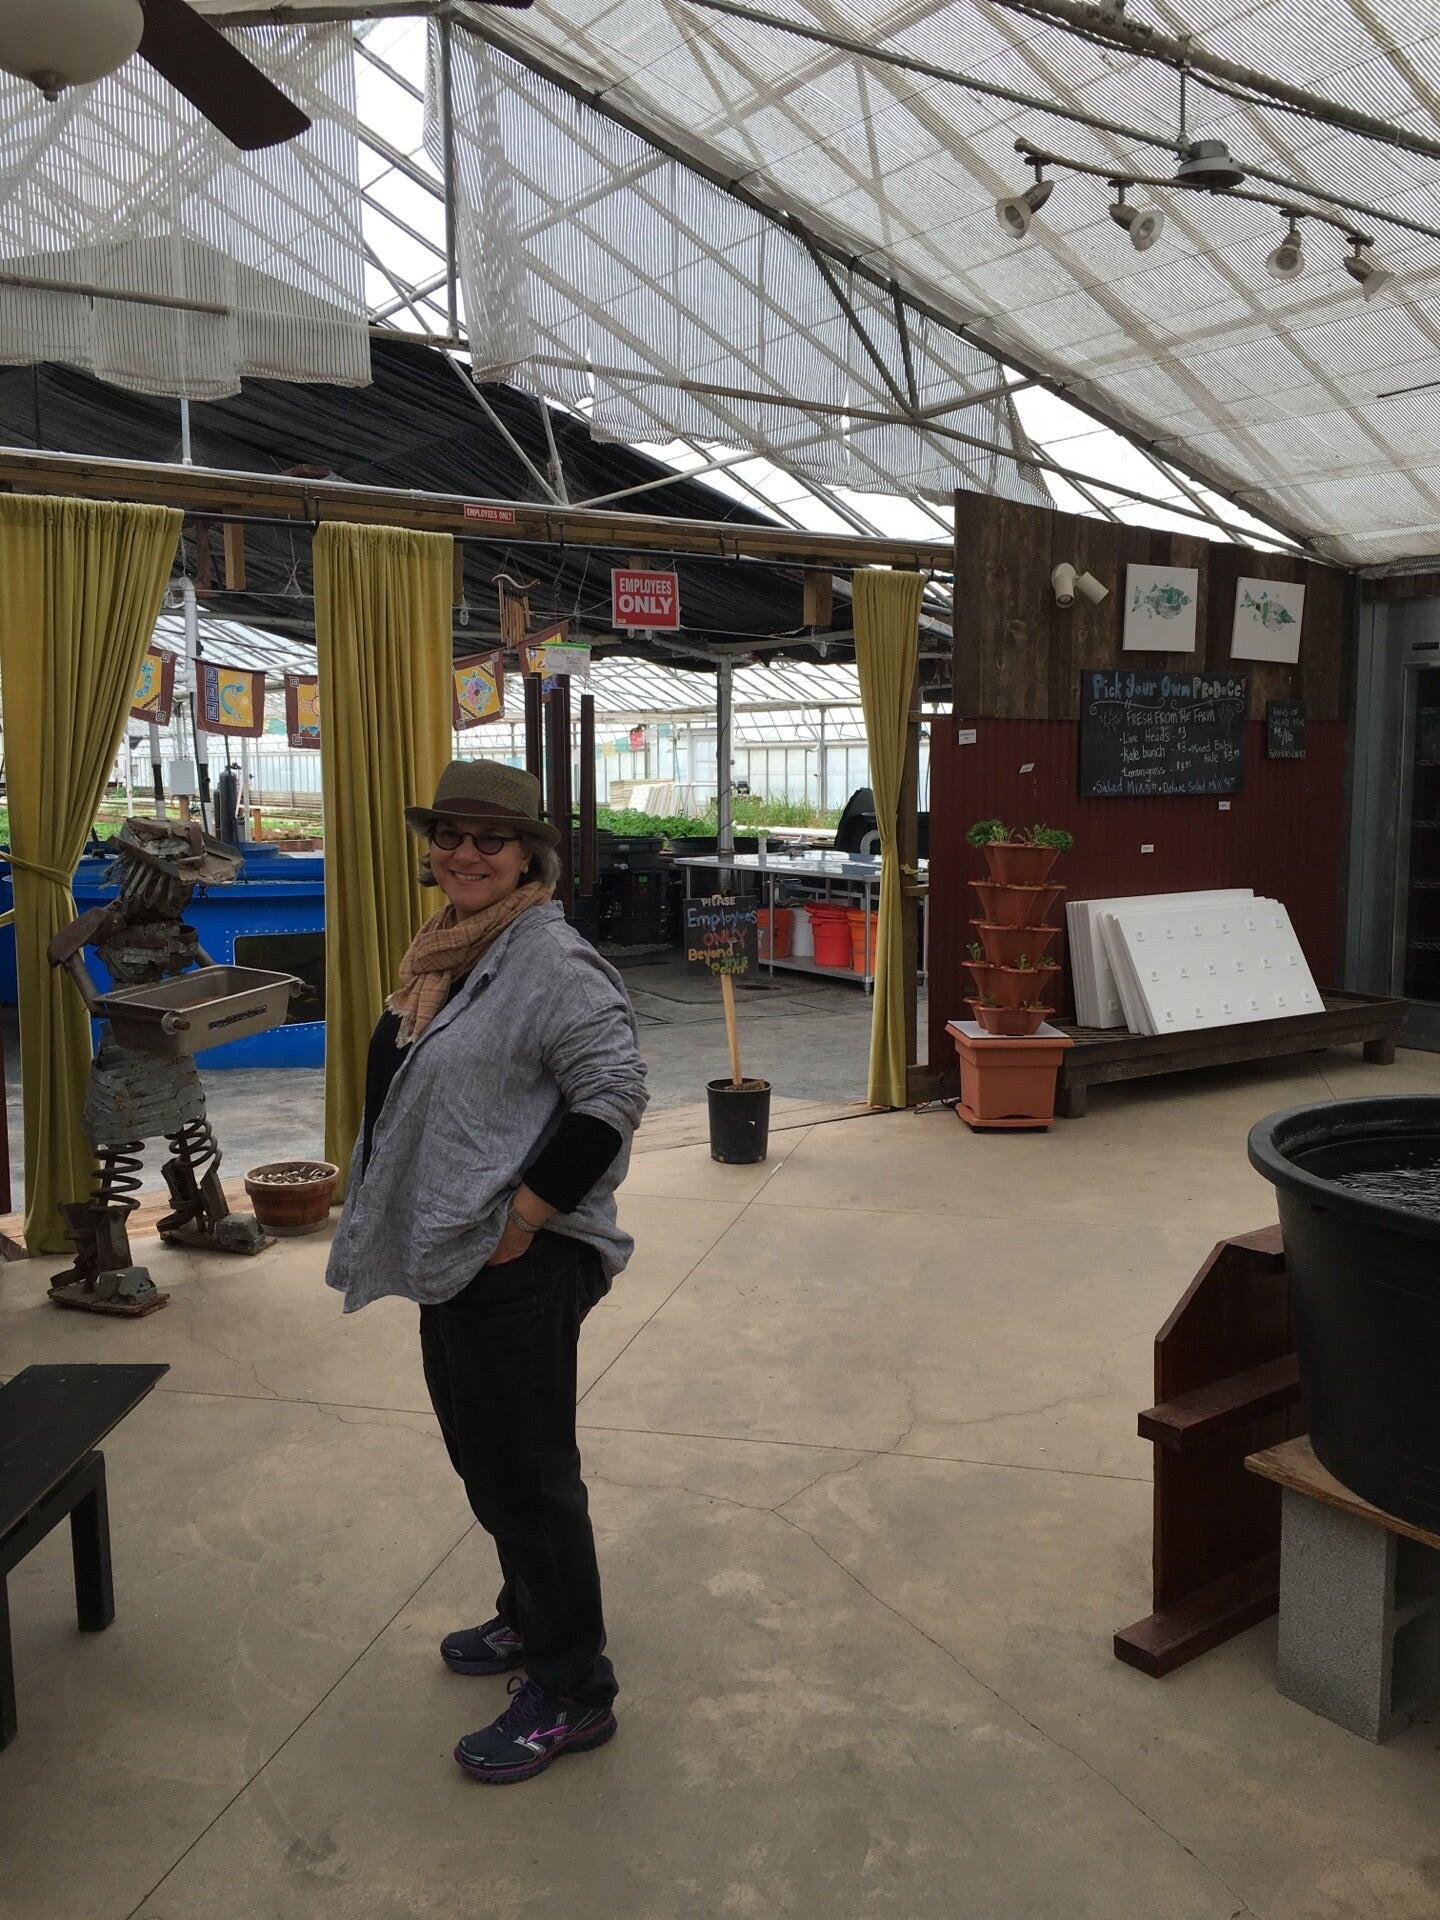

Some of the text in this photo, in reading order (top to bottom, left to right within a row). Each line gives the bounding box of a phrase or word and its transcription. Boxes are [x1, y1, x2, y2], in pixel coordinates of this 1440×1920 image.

[466, 508, 512, 520] EMPLOYEES ONLY
[619, 577, 672, 595] EMPLOYEES
[618, 594, 674, 615] ONLY
[1092, 672, 1122, 699] Pick
[1126, 672, 1158, 698] Your
[1161, 675, 1191, 698] Own
[1126, 708, 1216, 727] FRESH FROM THE FARM
[1123, 731, 1139, 745] Live
[1145, 726, 1171, 743] Heads
[1123, 746, 1141, 763] Kale
[1142, 744, 1166, 760] bunch
[1096, 777, 1123, 794] Salad
[701, 894, 736, 907] PLEASE
[687, 907, 757, 932] Employees
[703, 928, 748, 947] ONLY
[688, 944, 734, 966] Beyond
